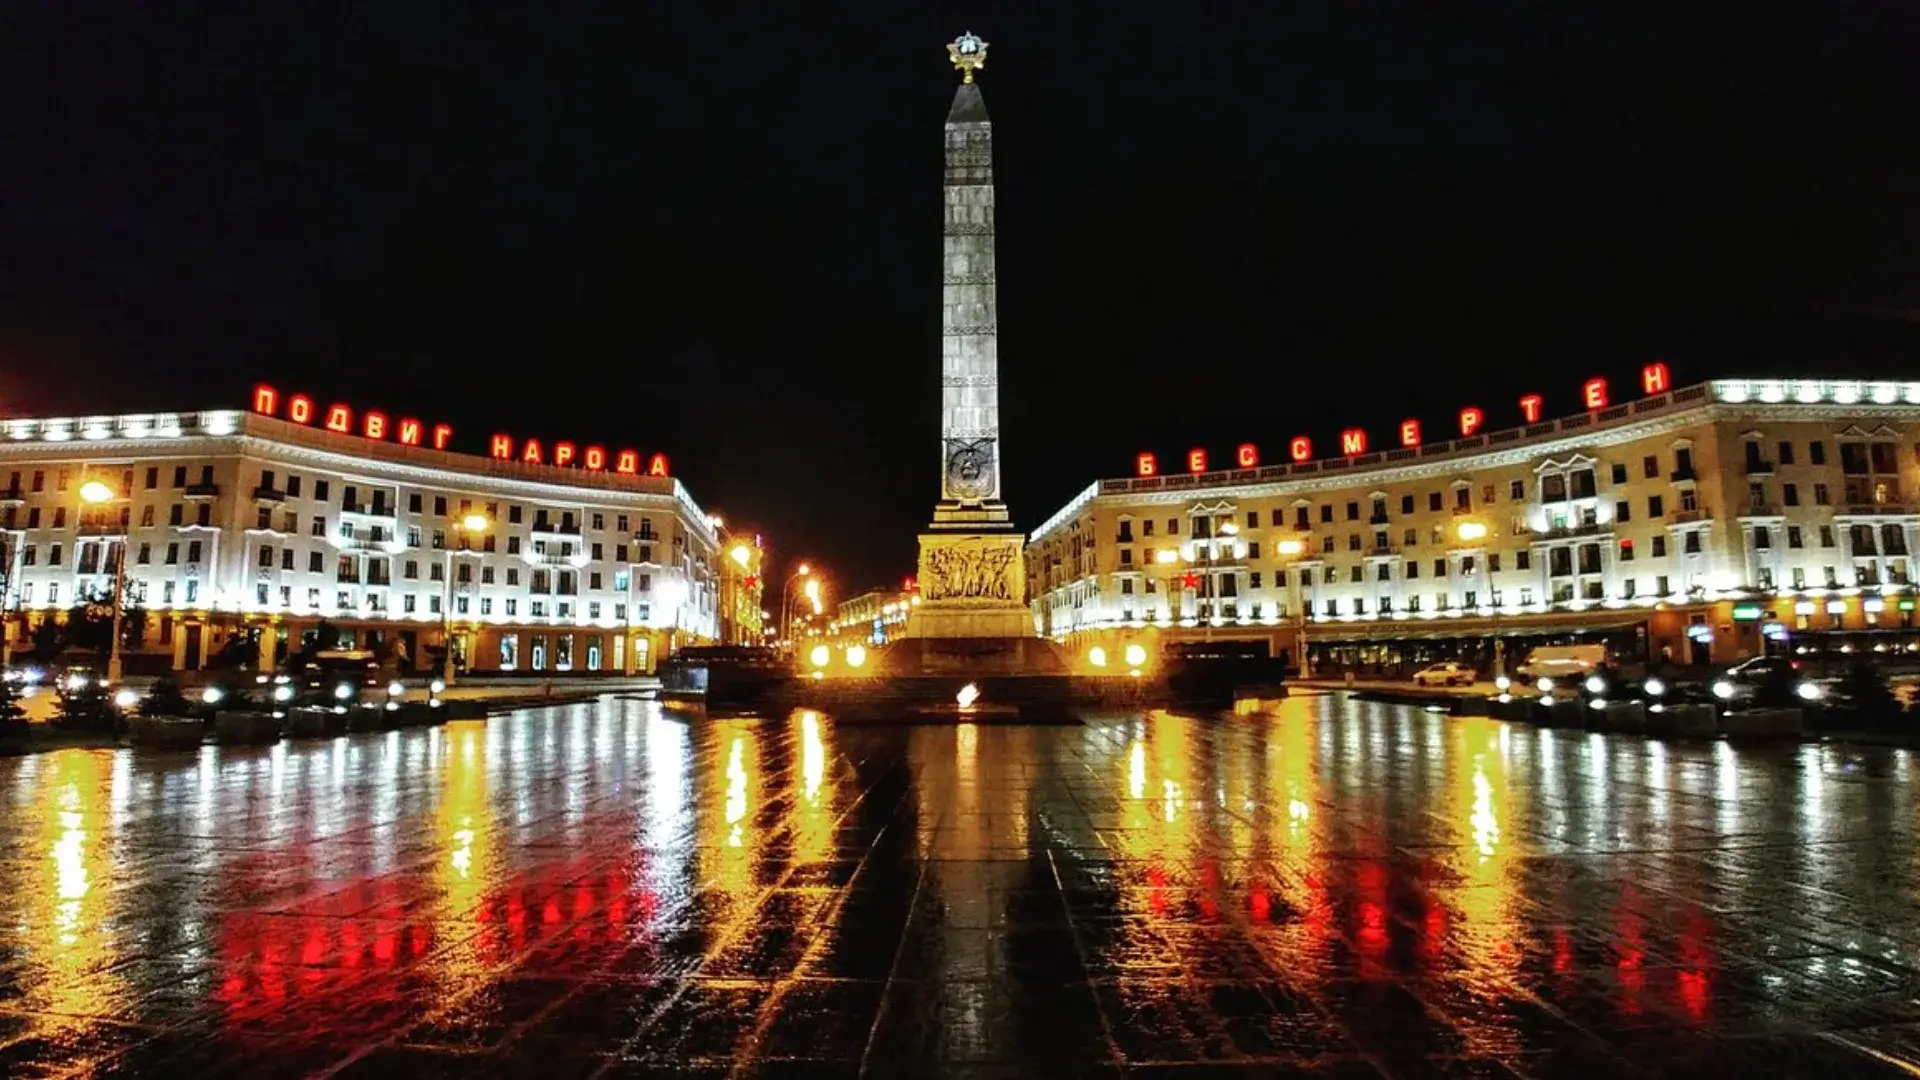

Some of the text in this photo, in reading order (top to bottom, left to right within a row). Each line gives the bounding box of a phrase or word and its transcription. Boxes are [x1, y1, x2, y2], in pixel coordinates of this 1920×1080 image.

[255, 386, 668, 477] ПОДВИГ НАРОДА
[1139, 365, 1668, 475] БЕССМЕРТЕН
